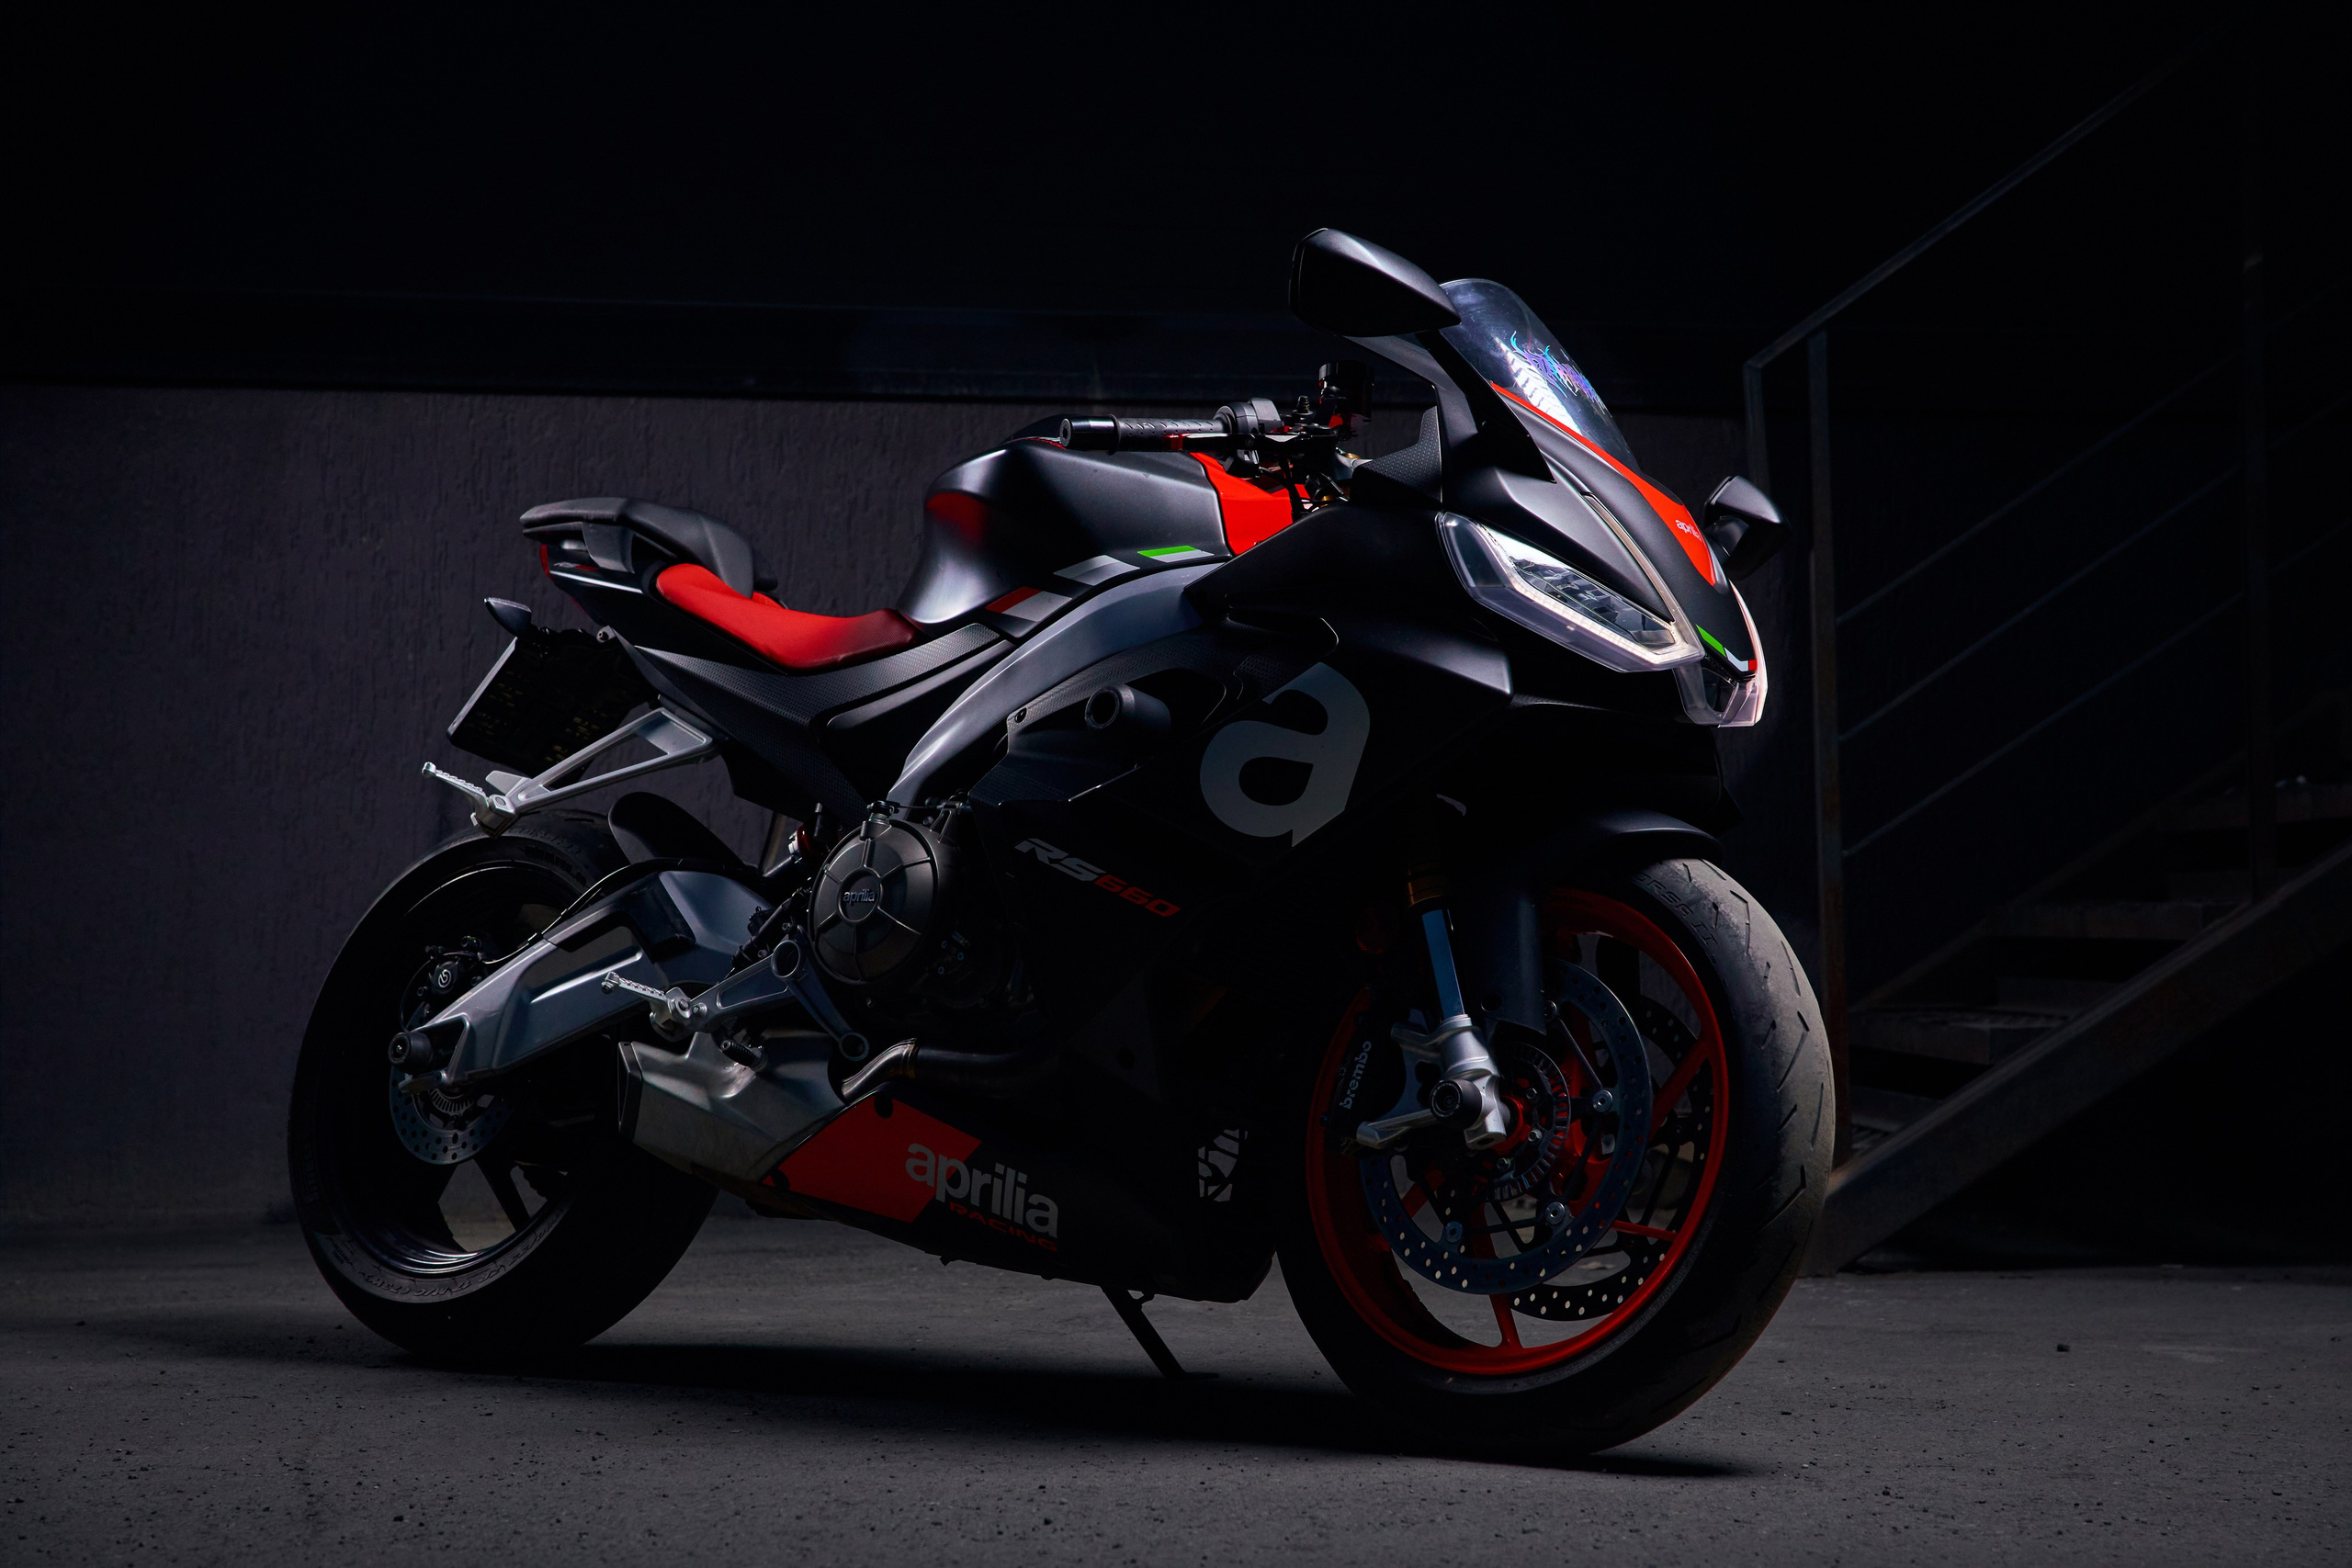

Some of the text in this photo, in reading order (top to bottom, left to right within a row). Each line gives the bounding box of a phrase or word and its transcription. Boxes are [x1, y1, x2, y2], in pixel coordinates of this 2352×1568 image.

[842, 888, 876, 905] aprilia
[1339, 1040, 1373, 1110] brembo
[905, 1143, 1058, 1238] aprilia
[948, 1200, 1057, 1253] RACING
